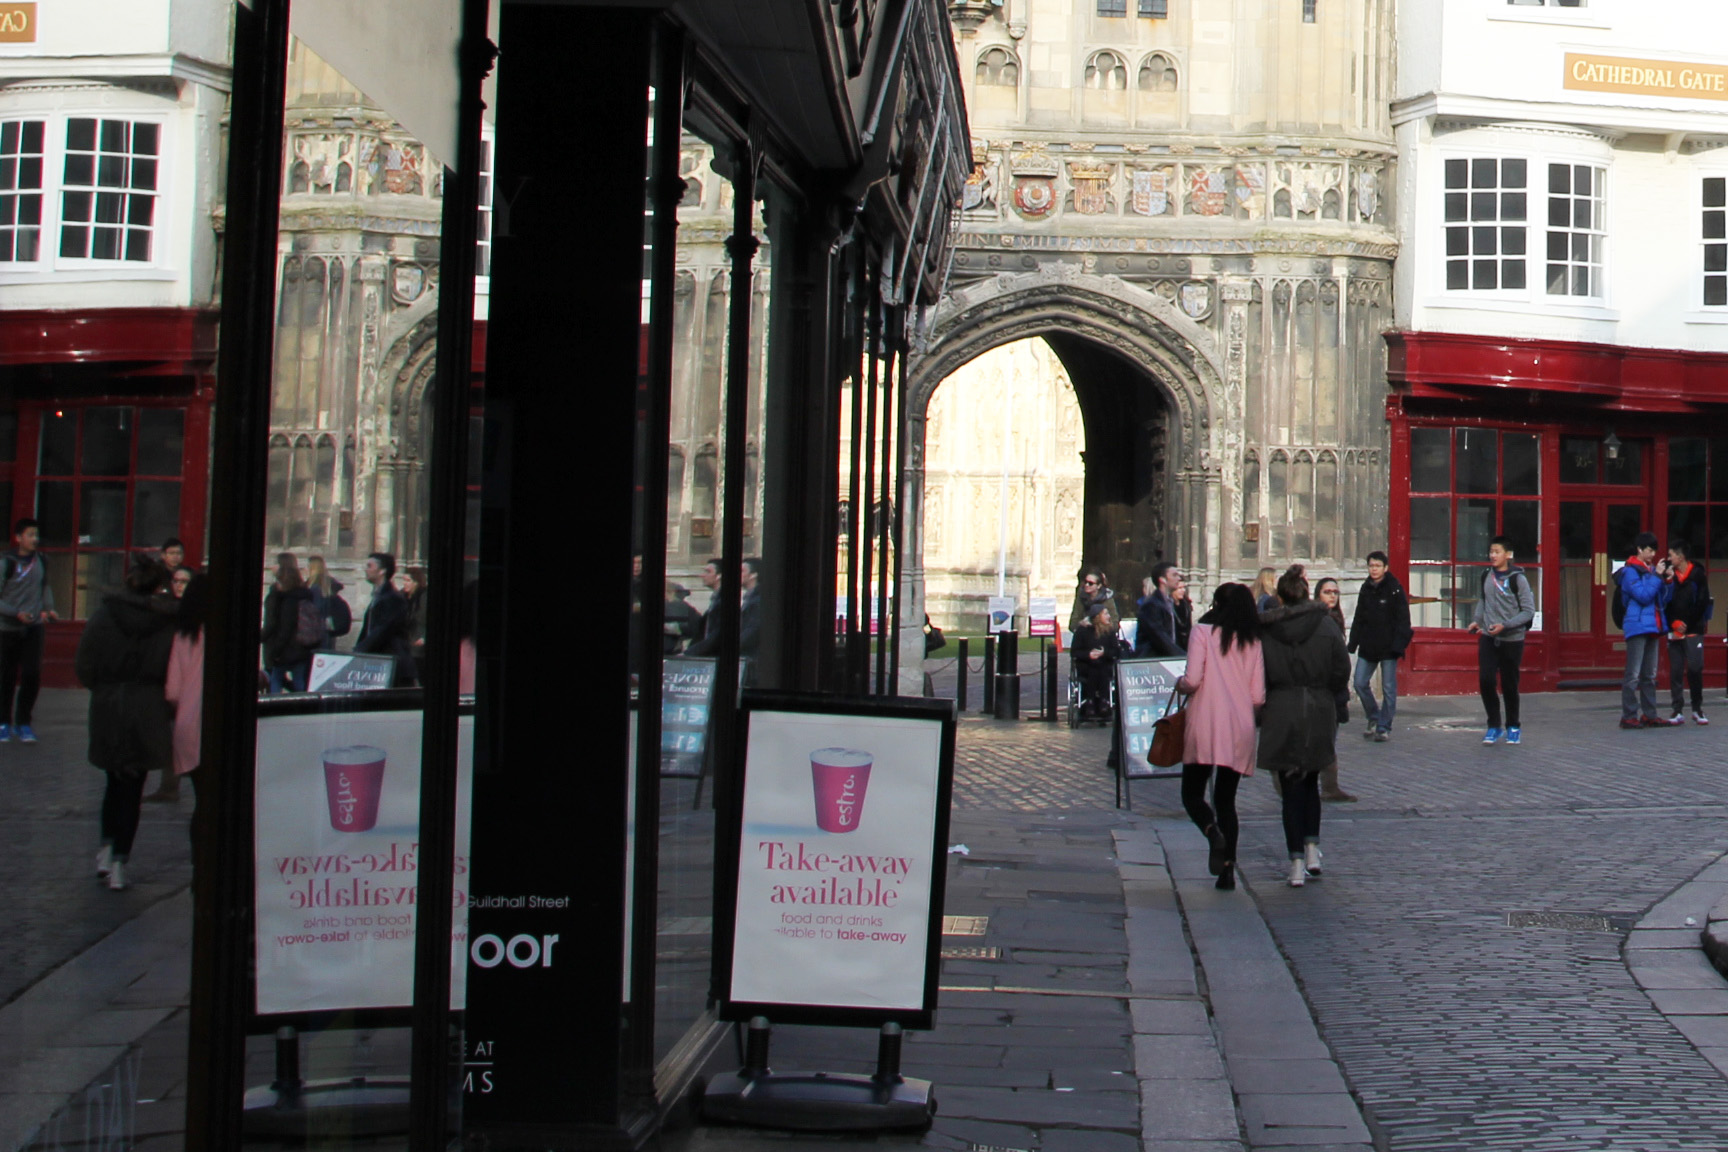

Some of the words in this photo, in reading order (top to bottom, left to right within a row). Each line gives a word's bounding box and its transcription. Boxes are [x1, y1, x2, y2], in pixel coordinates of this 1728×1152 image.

[1572, 61, 1675, 88] CATHEDRAL
[1679, 69, 1725, 92] GATE
[1126, 674, 1166, 686] MONEY
[1126, 685, 1157, 696] ground
[759, 841, 915, 885] Take-away
[770, 877, 898, 908] available
[467, 894, 526, 909] Guildhall
[528, 894, 571, 909] Street
[781, 912, 812, 925] food
[816, 914, 842, 926] and
[846, 915, 883, 928] drinks
[820, 928, 833, 940] to
[837, 929, 907, 945] take-away
[470, 933, 560, 969] oor
[474, 1040, 495, 1057] AT
